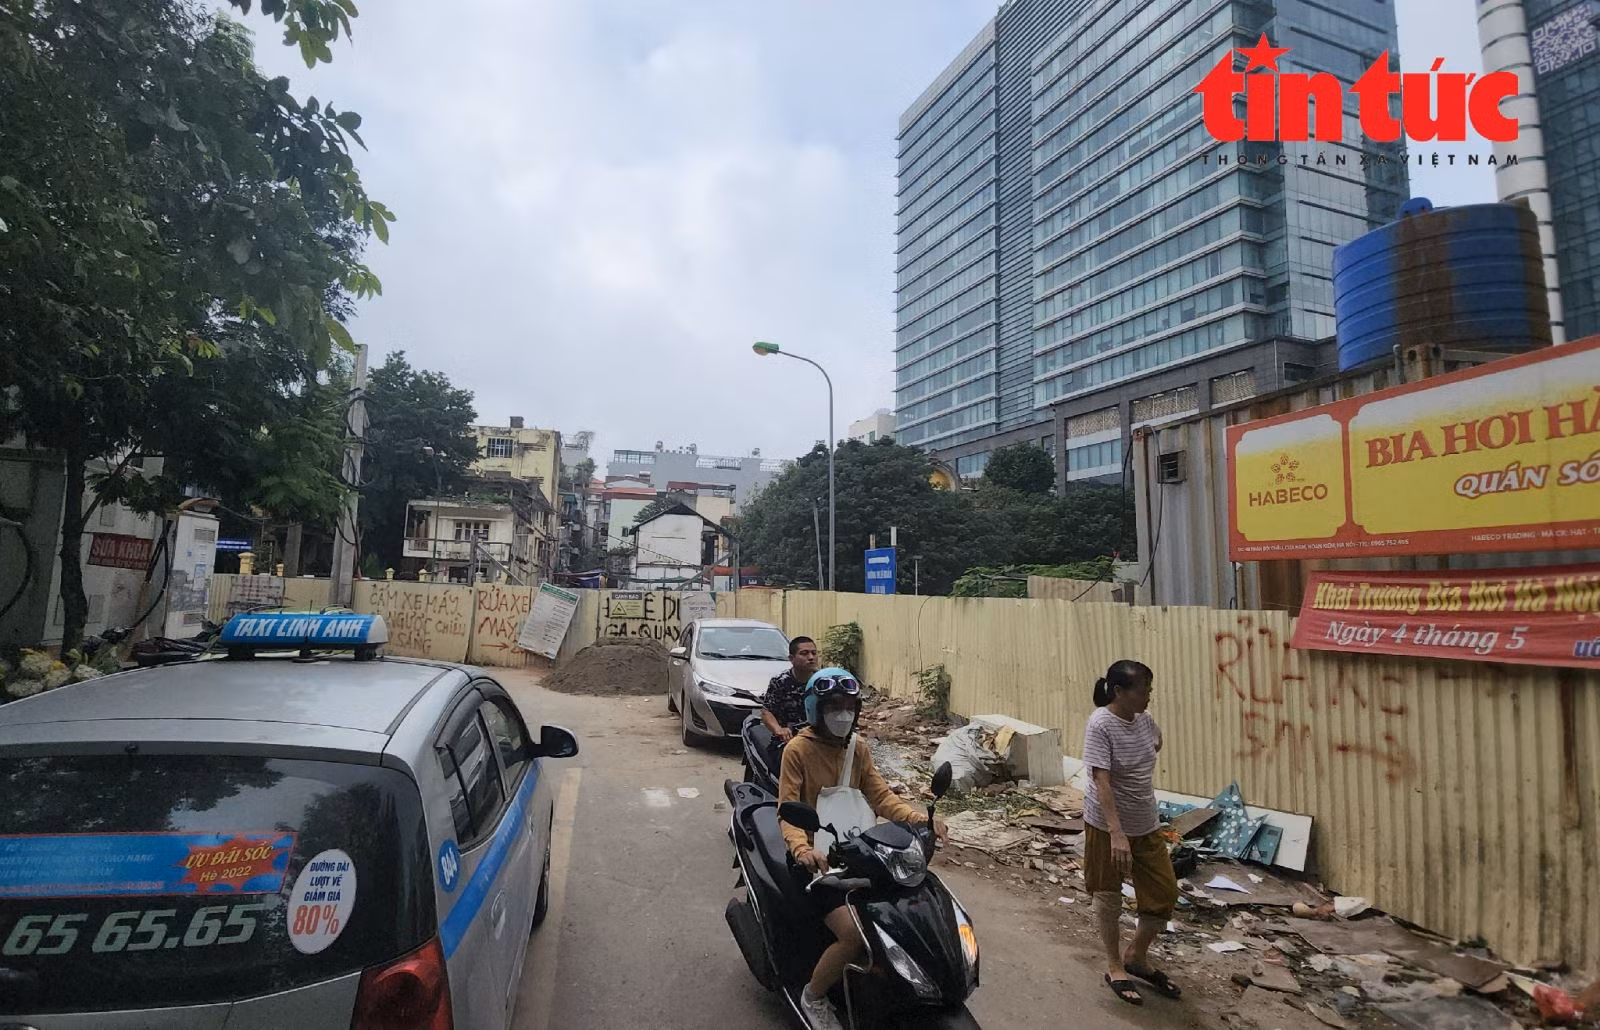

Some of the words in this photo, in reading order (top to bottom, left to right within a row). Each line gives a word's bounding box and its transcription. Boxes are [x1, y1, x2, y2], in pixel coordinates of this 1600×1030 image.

[1365, 430, 1437, 468] BIA
[1440, 409, 1535, 457] HƠI
[1454, 460, 1550, 499] QUÁN
[1248, 484, 1328, 507] HABECO
[1471, 534, 1501, 542] HABECO
[402, 591, 423, 611] XE
[510, 593, 529, 615] XE
[1313, 582, 1355, 610] Khai
[1425, 580, 1463, 612] Bia
[234, 618, 278, 637] TAXI
[276, 618, 323, 637] LINH
[322, 619, 365, 638] ANH
[1325, 620, 1388, 648] Ngày
[1391, 623, 1408, 644] 4
[1412, 623, 1499, 655] tháng
[1505, 626, 1529, 649] 5
[242, 841, 273, 861] SỐC
[200, 870, 218, 882] Hè
[221, 865, 252, 880] 2022
[2, 913, 90, 956] 65
[92, 903, 272, 953] 65.65
[292, 903, 340, 936] 80%
